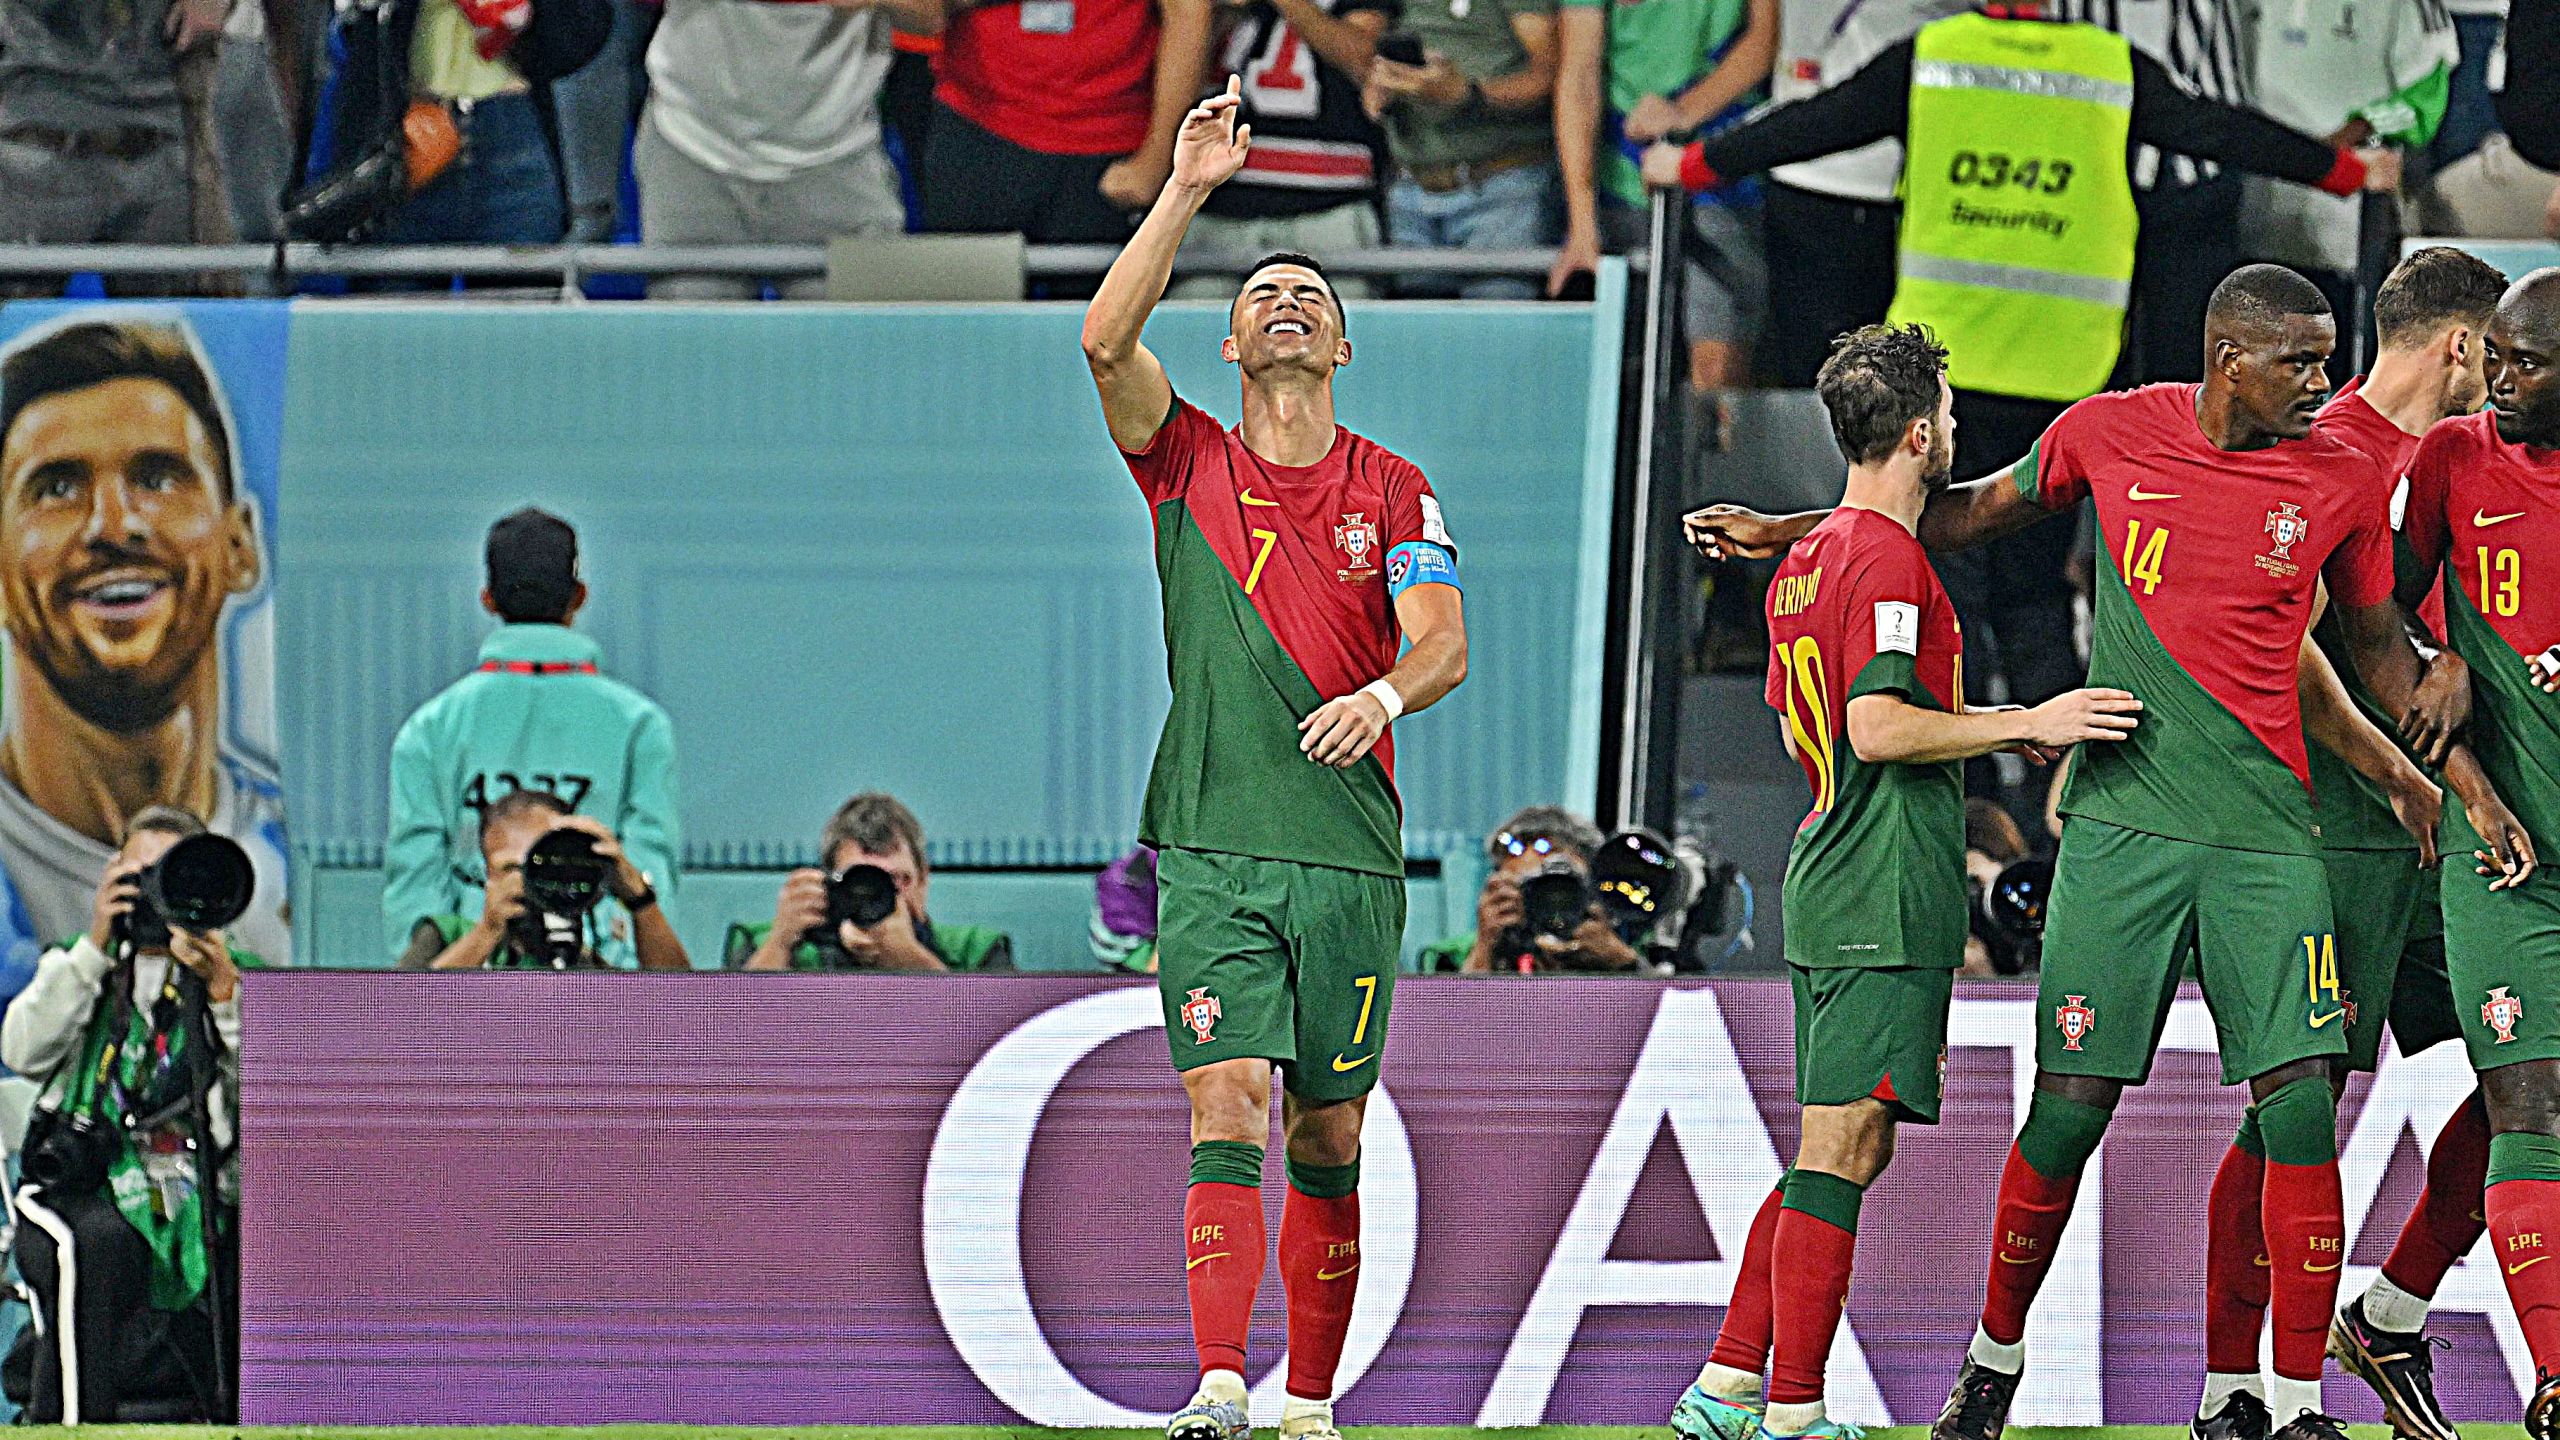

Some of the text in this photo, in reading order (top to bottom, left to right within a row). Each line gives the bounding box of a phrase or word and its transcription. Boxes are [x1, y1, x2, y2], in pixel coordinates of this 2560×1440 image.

[1949, 150, 2073, 194] 0343
[1244, 528, 1278, 595] 7
[2123, 519, 2170, 596] 14
[2477, 546, 2520, 617] 13
[1776, 635, 1835, 813] 10
[2303, 934, 2340, 1004] 14
[1352, 976, 1377, 1044] 7
